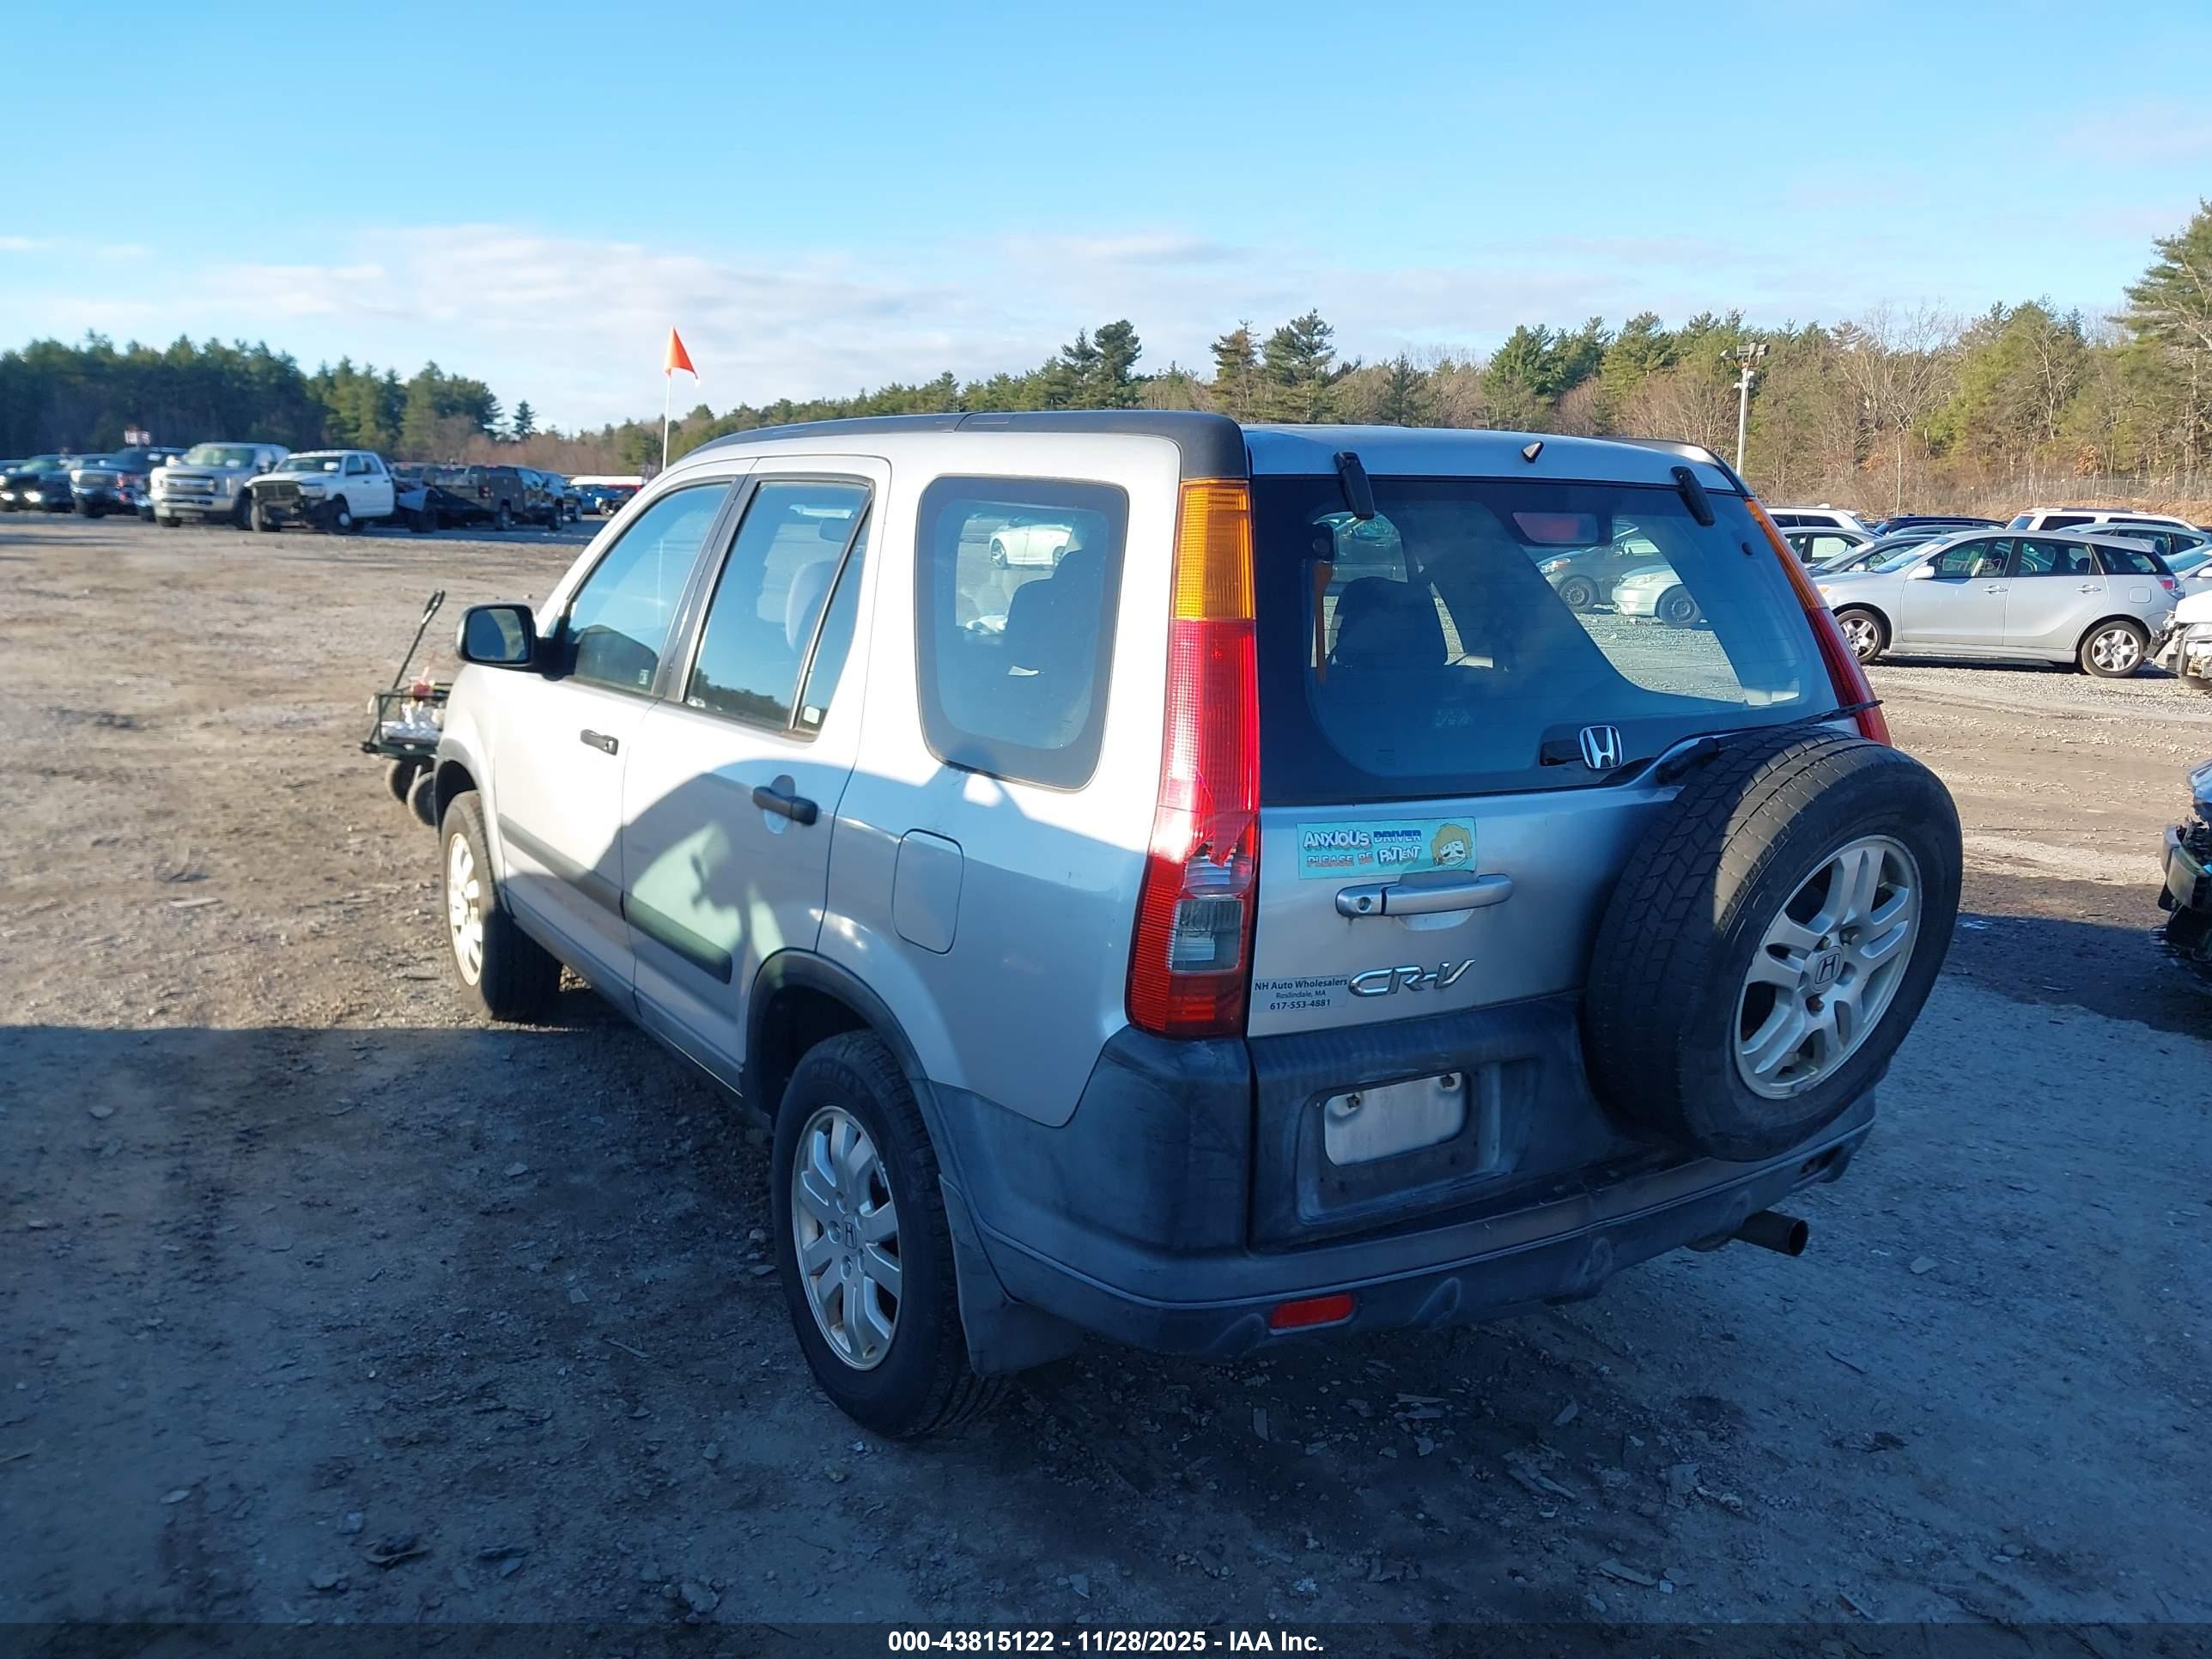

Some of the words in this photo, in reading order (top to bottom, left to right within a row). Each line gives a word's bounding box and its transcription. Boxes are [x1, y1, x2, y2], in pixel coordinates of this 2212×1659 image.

[1304, 830, 1371, 849] ANXIOUS
[1374, 830, 1422, 844] DRIVER
[1307, 854, 1354, 866] PLEASE
[1358, 851, 1374, 865] BE
[1378, 846, 1421, 866] PATIENT
[1255, 981, 1269, 991] NH
[1271, 981, 1292, 990] Auto
[1294, 978, 1348, 989] Wholesalers
[1348, 958, 1476, 998] CR-V
[1276, 989, 1313, 1000] Roslindale,
[1270, 999, 1331, 1011] 617-553-4881
